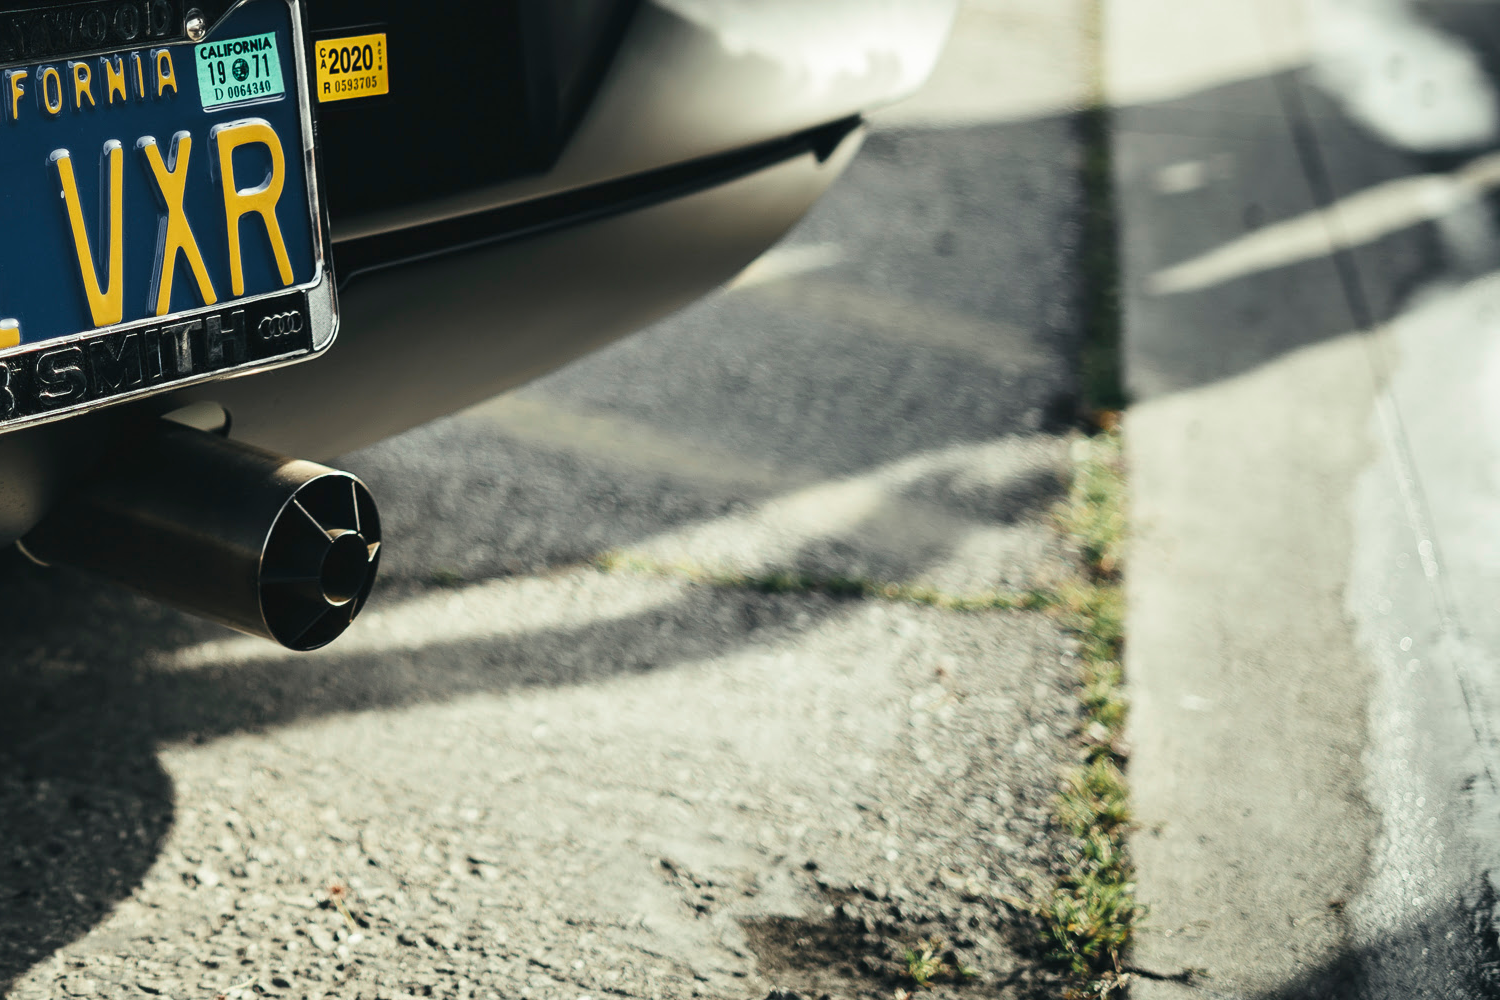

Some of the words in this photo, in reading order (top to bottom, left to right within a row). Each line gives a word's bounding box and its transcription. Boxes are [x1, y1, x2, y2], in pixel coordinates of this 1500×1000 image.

[200, 36, 272, 60] CALIFORNIA
[328, 44, 374, 75] 2020
[214, 87, 224, 101] D
[227, 79, 272, 99] 0064340
[323, 81, 331, 95] R
[334, 75, 378, 93] 0593705
[51, 119, 296, 328] VXR
[36, 309, 248, 407] SMITH
